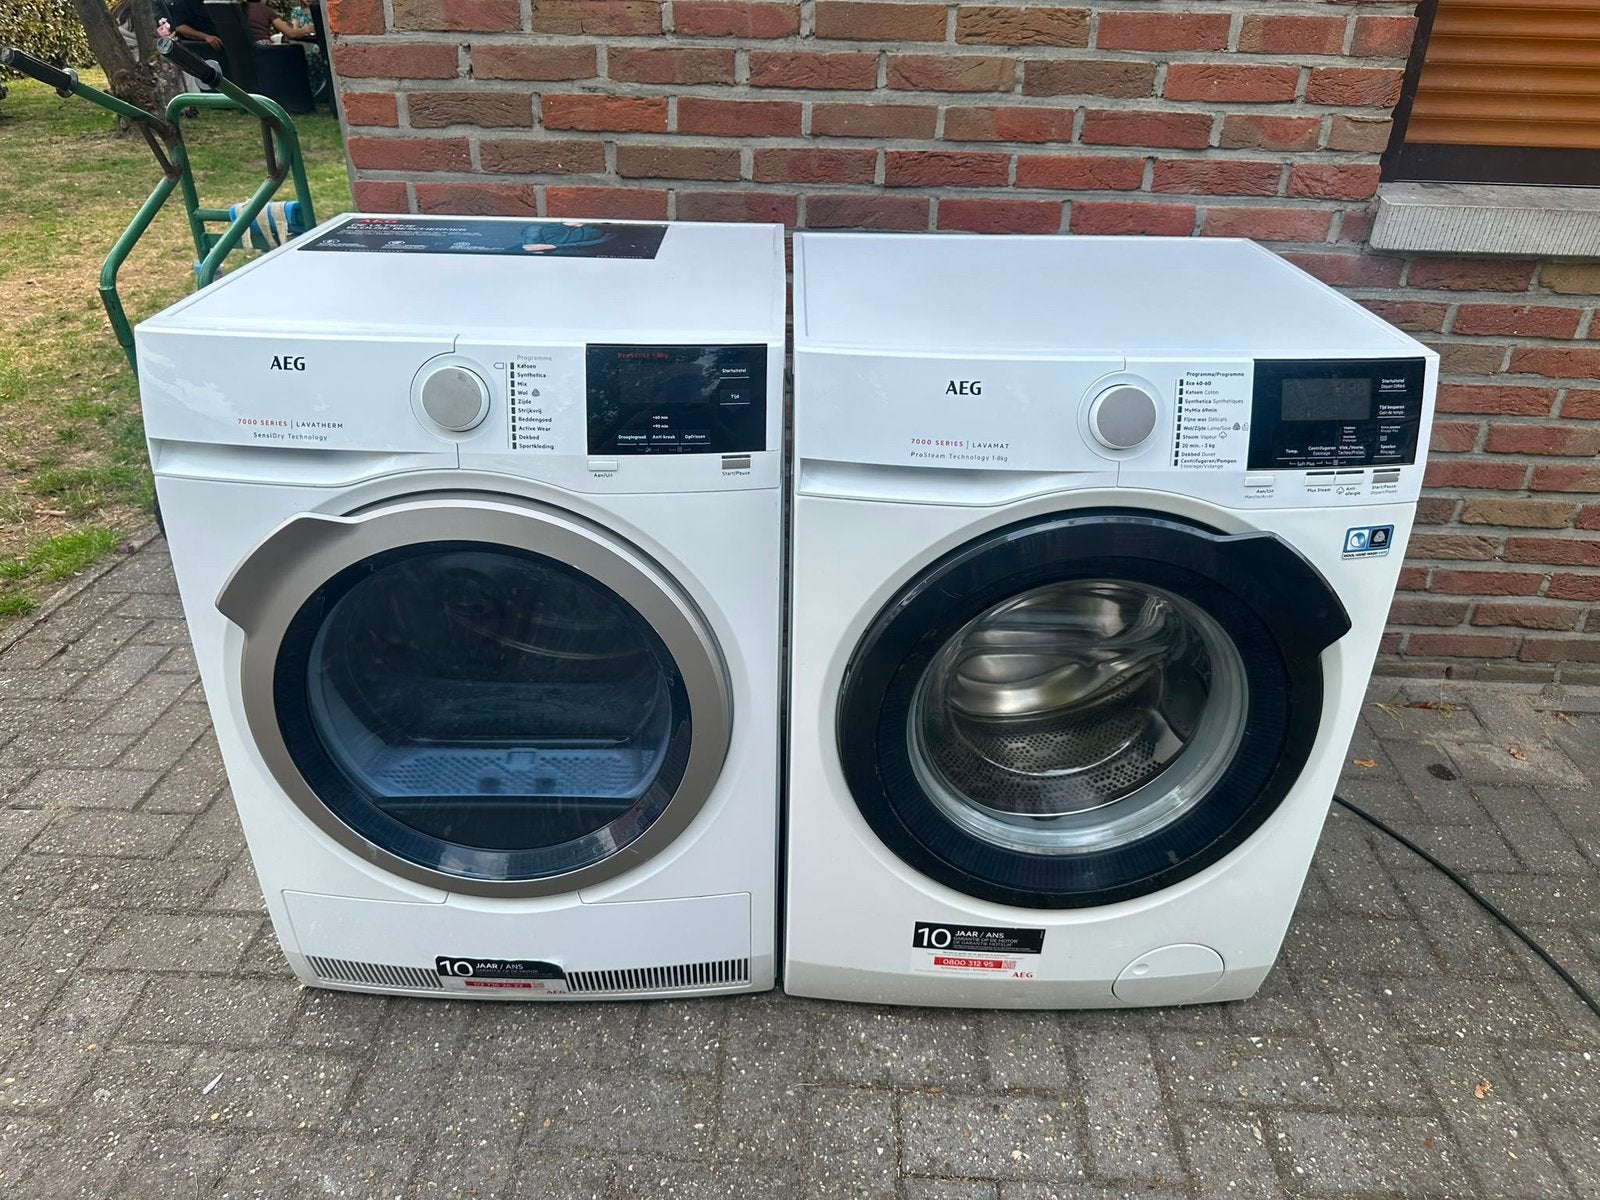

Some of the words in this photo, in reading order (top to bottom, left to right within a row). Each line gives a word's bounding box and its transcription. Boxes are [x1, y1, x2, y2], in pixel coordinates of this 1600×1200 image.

[270, 356, 306, 371] AEG
[945, 380, 982, 395] AEG
[288, 433, 328, 441] Technology
[910, 451, 946, 459] ProSteam
[949, 453, 989, 461] Technology
[918, 927, 952, 948] 10
[955, 930, 979, 938] JAAR
[440, 960, 474, 977] 10
[942, 958, 966, 966] 0800
